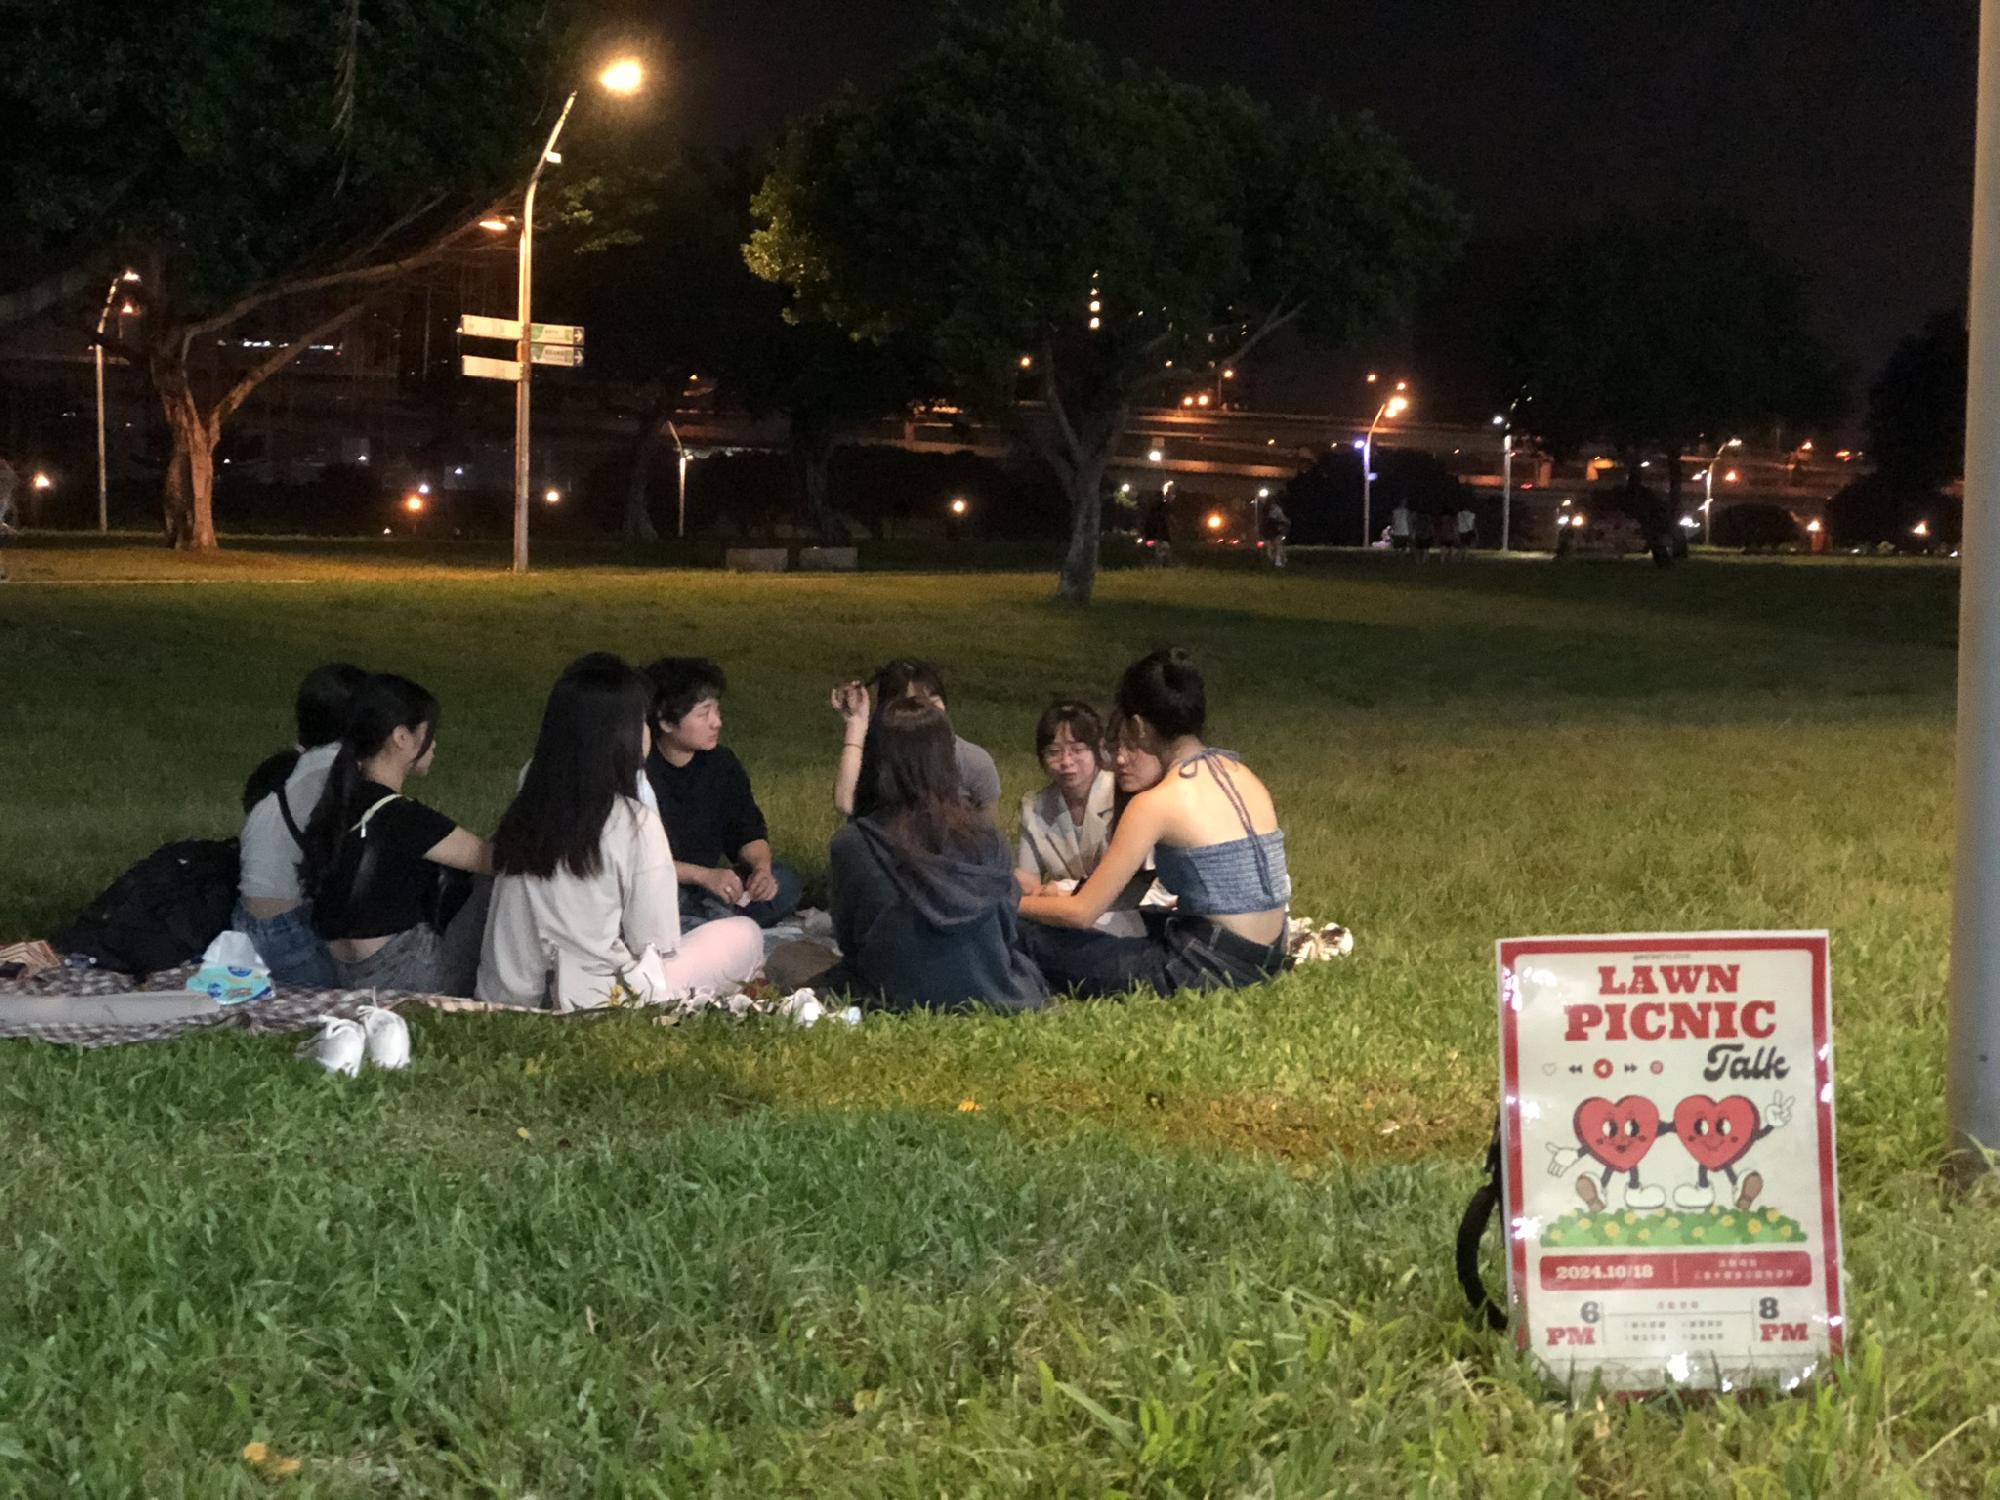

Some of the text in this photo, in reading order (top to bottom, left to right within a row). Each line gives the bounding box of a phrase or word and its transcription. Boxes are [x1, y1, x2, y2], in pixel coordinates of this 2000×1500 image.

[1598, 964, 1740, 995] LAWN
[1564, 1000, 1776, 1041] PICNIC
[1703, 1043, 1791, 1082] Talk
[1580, 1301, 1600, 1323] 6
[1759, 1297, 1780, 1320] 8
[1546, 1327, 1596, 1346] PM
[1760, 1323, 1809, 1342] PM
